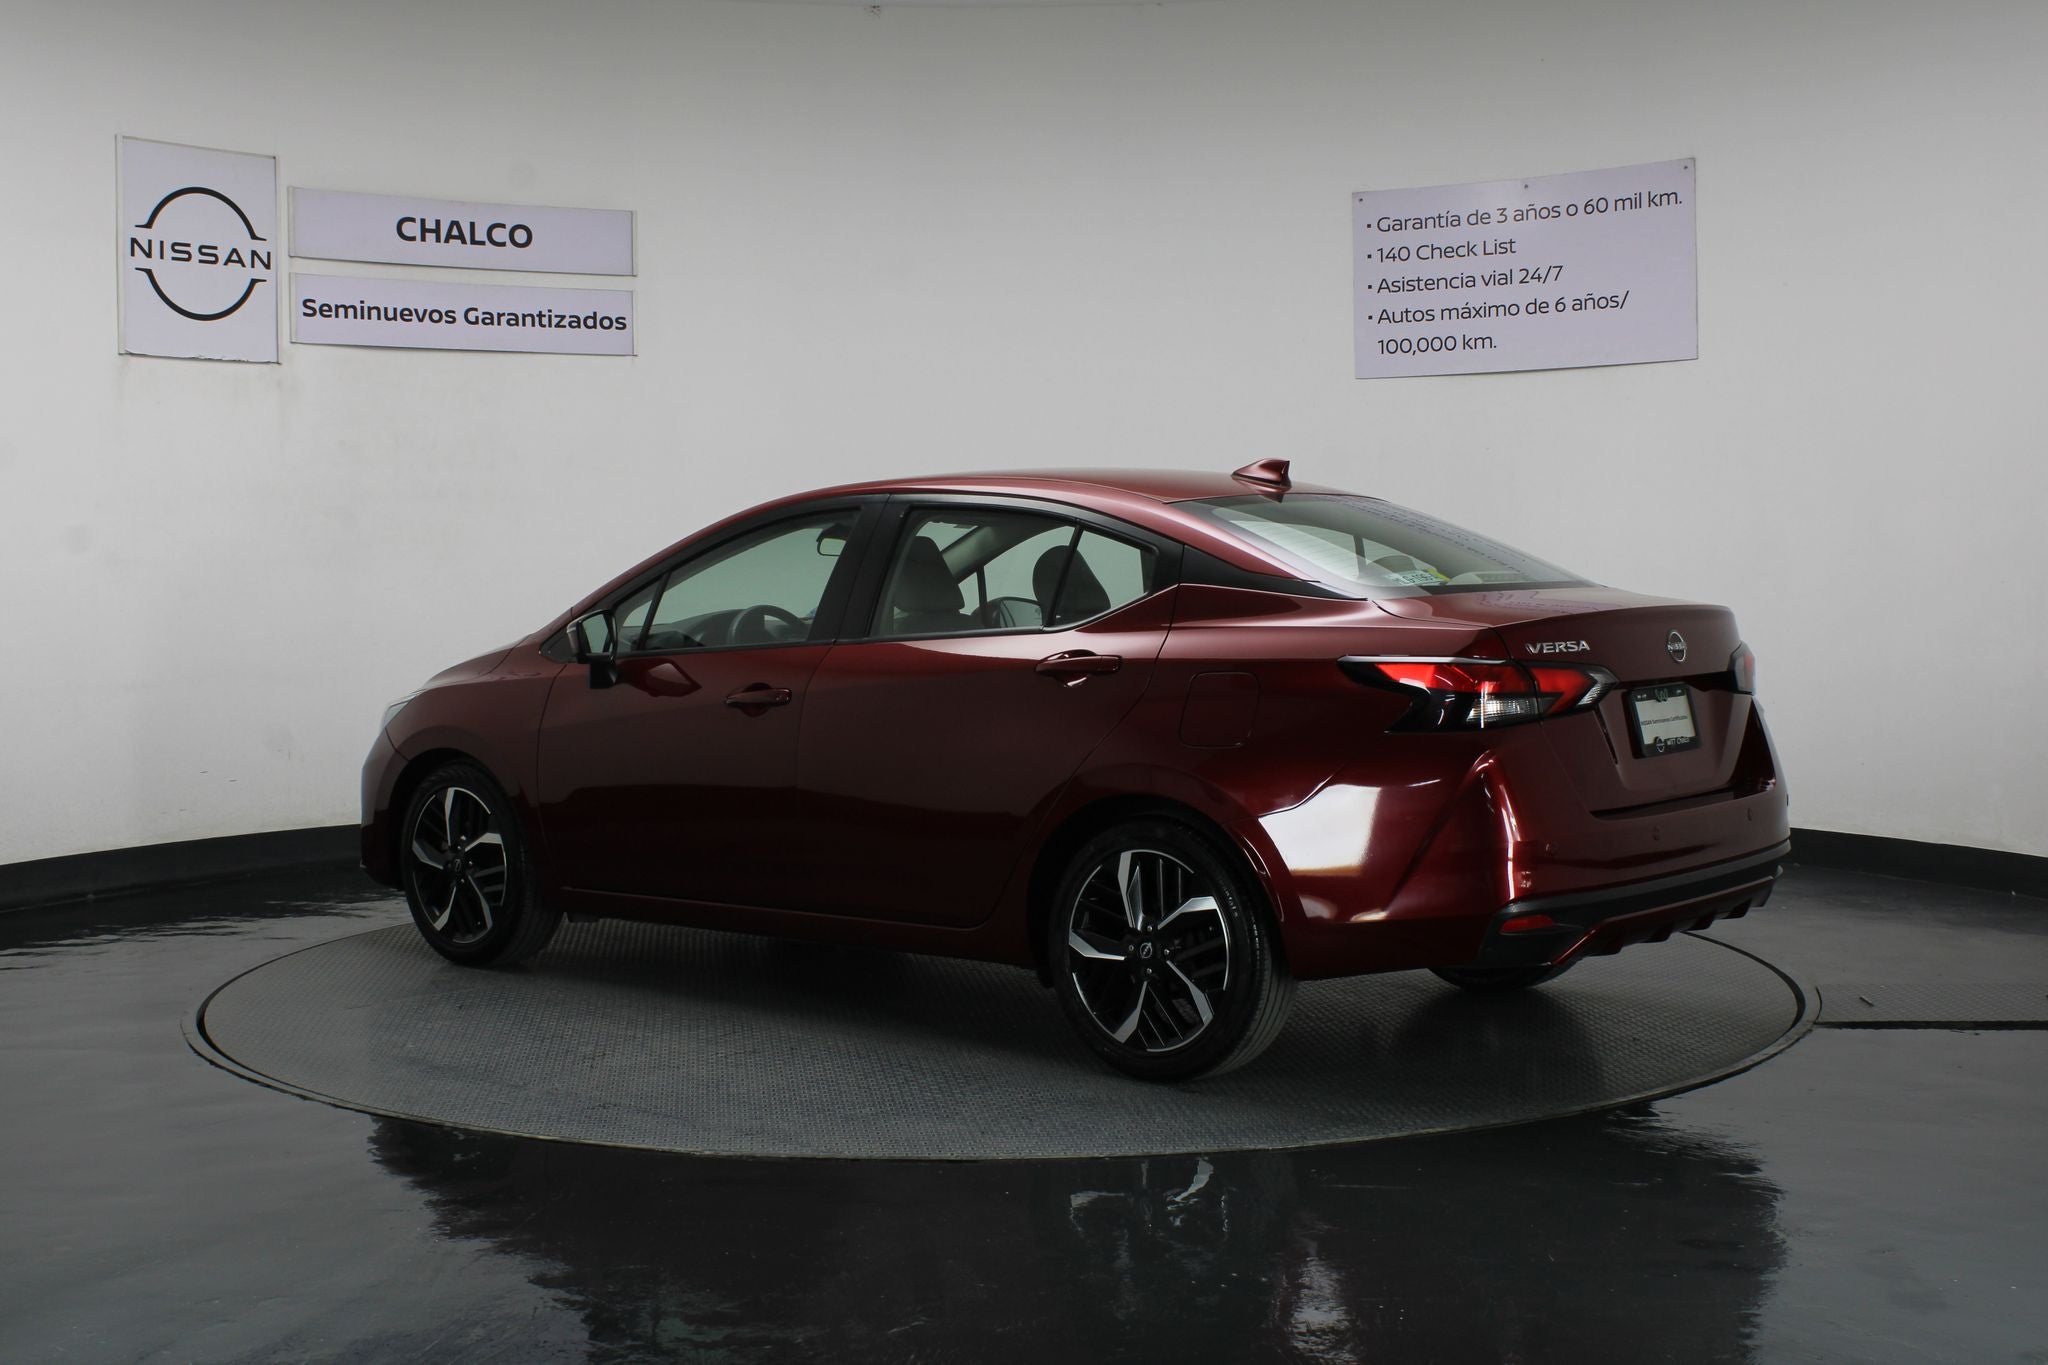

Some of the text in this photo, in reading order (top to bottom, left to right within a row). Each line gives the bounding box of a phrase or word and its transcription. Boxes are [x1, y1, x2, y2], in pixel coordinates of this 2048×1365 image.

[1376, 190, 1683, 233] Garantía de 3 años o 60 mil km.
[396, 216, 533, 249] CHALCO
[129, 236, 272, 271] NISSAN
[1376, 238, 1517, 263] 140 Check List
[1376, 265, 1564, 294] Asistencia vial 24/7
[302, 298, 627, 331] Seminuevos Garantizados
[1377, 290, 1630, 325] Autos máximo de 6 años/
[1377, 334, 1497, 356] 100,000 km.
[1525, 640, 1591, 654] VERSA
